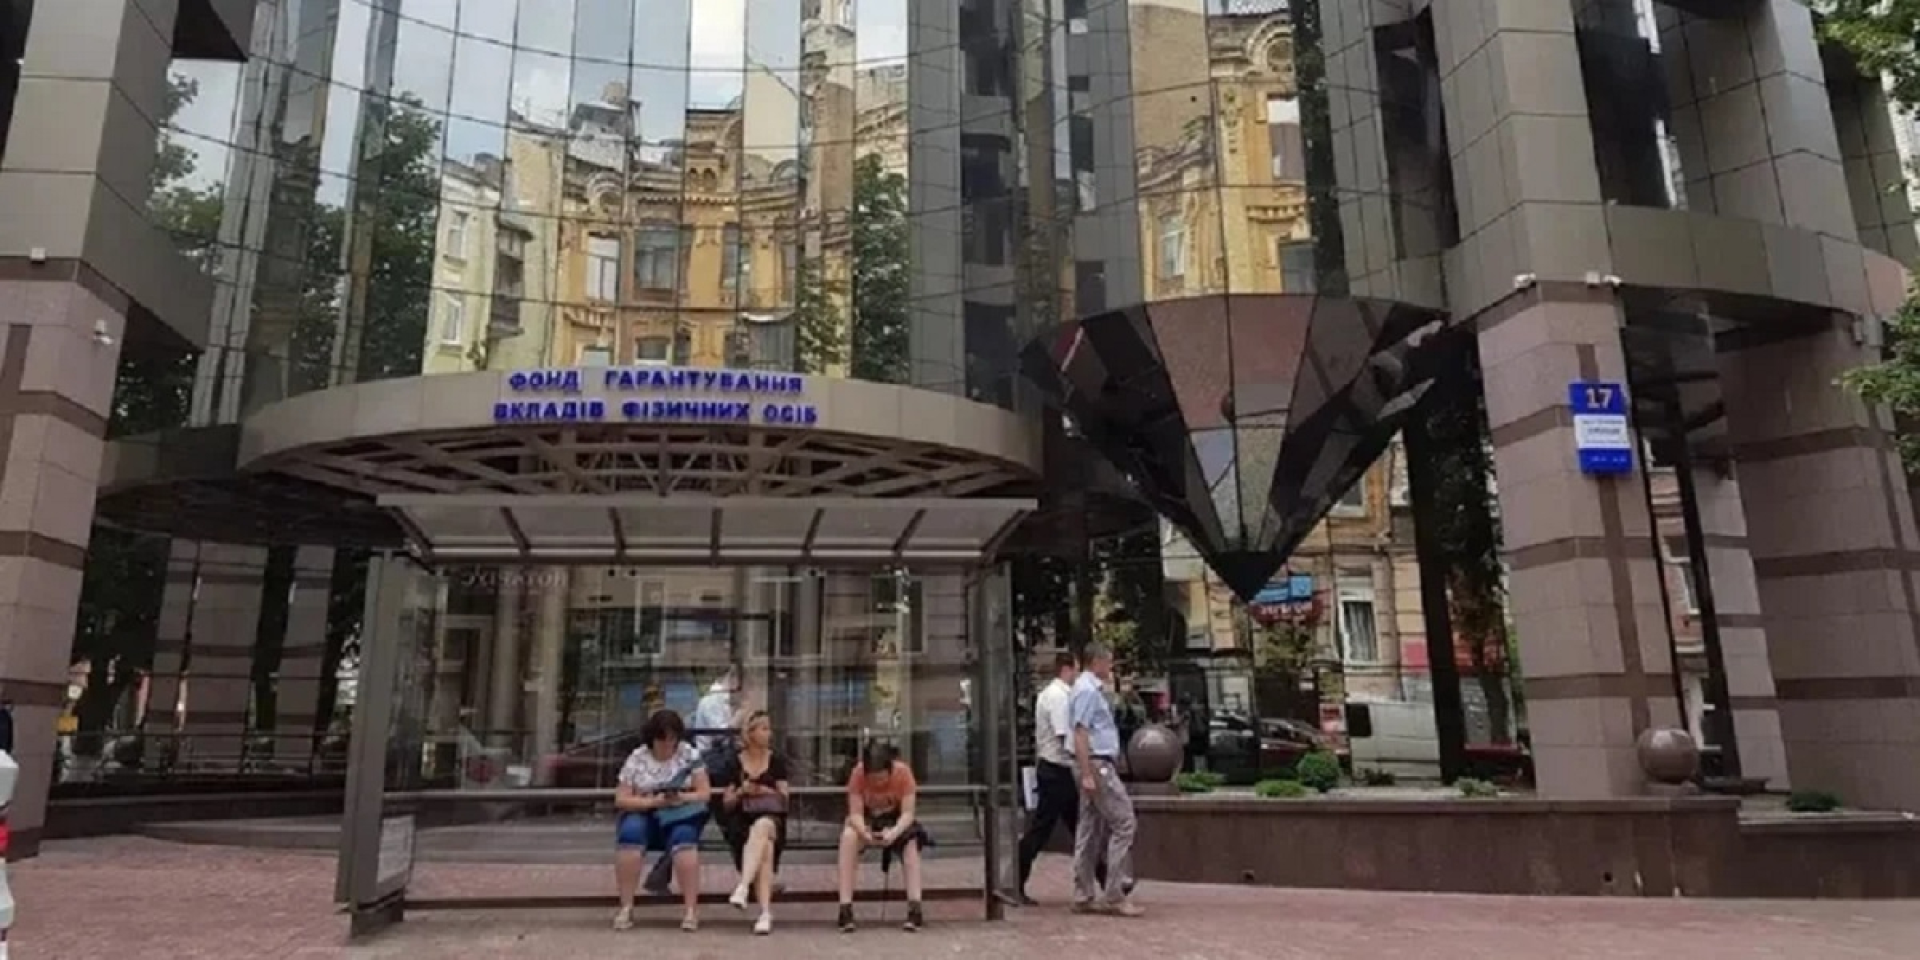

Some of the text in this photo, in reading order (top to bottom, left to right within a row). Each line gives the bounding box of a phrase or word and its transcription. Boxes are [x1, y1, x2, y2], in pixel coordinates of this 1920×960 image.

[509, 369, 802, 393] ФОНД ГАРАНТУВАННЯ
[1586, 387, 1613, 408] 17
[493, 401, 817, 424] ВКЛАДІВ ФІЗИЧНИХ ОСІБ
